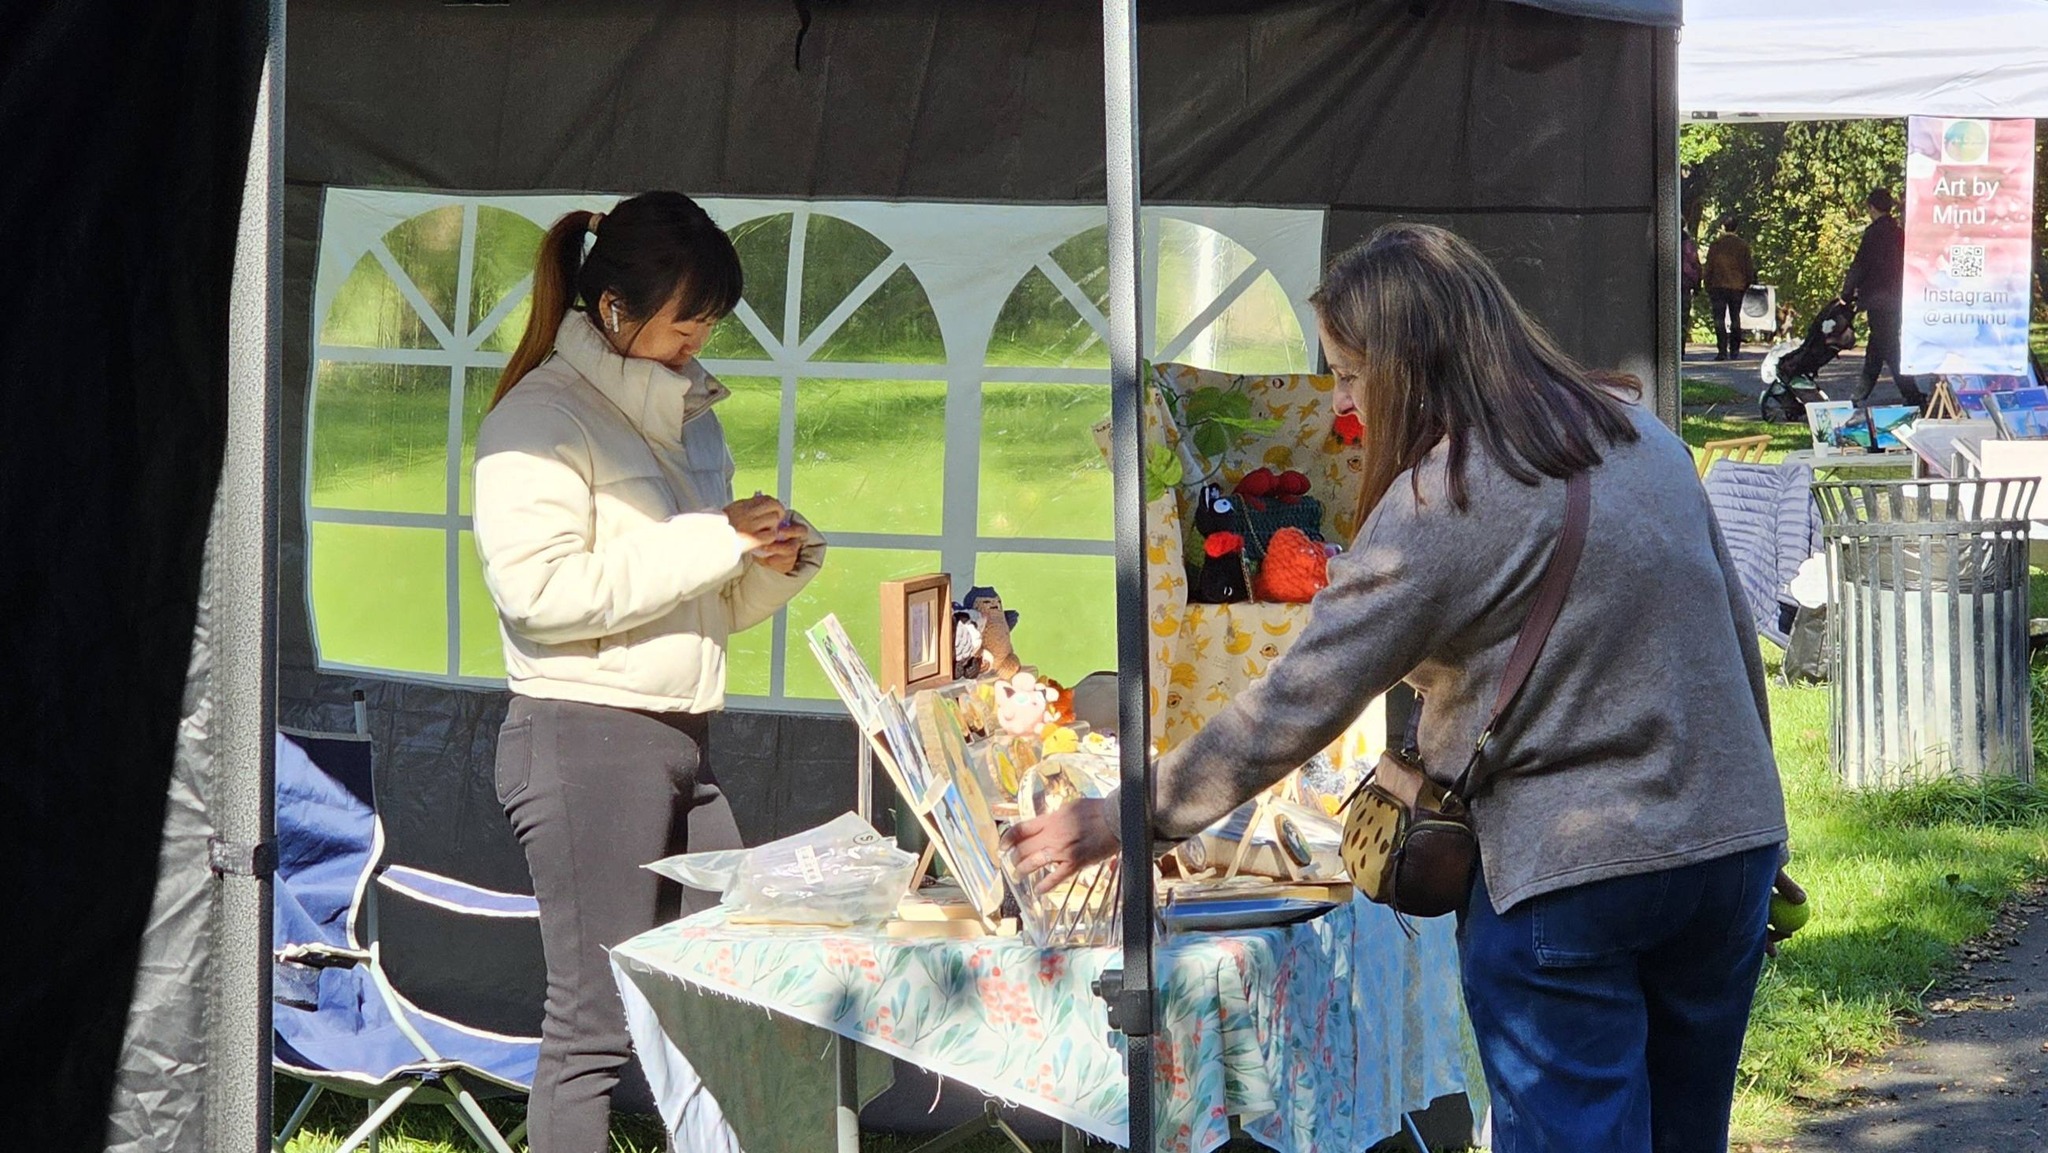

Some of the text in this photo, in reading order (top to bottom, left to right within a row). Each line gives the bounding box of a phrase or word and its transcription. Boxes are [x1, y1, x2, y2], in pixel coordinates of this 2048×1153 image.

[1933, 176, 1999, 201] Art by
[1923, 287, 2008, 307] Instagram
[1923, 309, 2006, 327] @artminu
